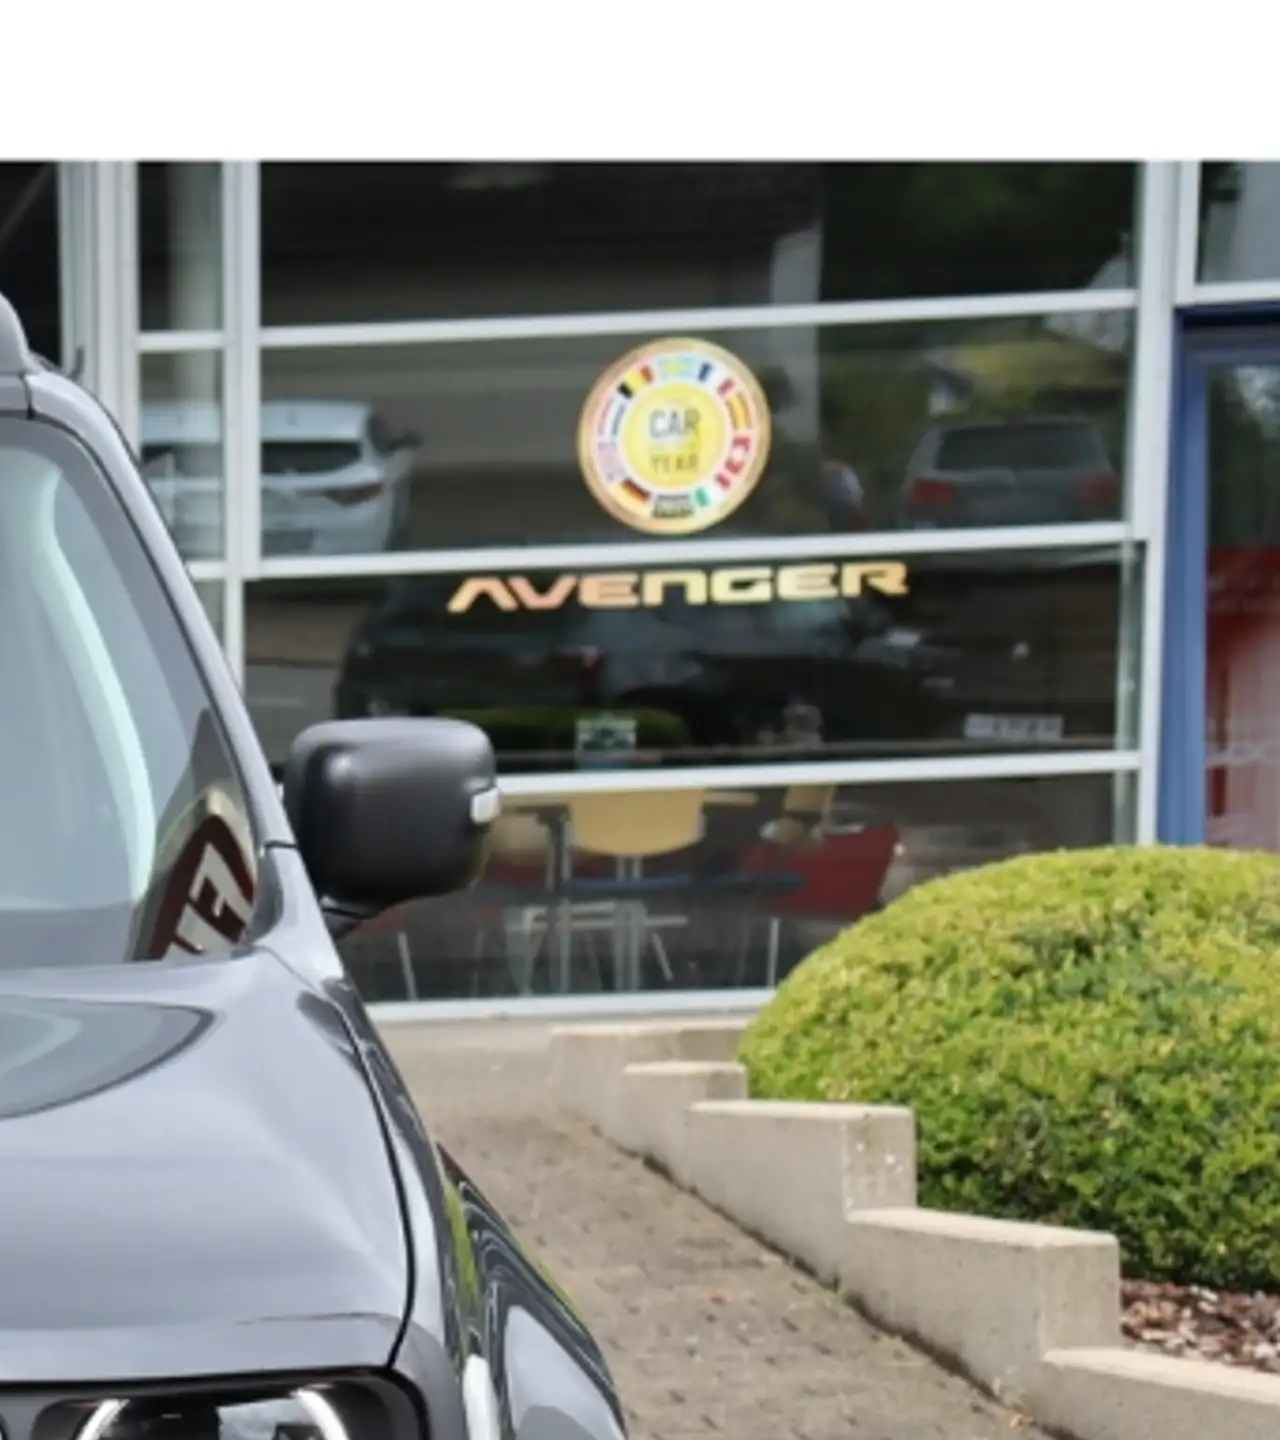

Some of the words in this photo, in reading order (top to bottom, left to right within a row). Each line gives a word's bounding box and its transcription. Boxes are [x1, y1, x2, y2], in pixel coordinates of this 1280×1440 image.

[649, 408, 701, 438] CAR
[650, 454, 699, 473] YEAR
[447, 561, 908, 612] AVENGER
